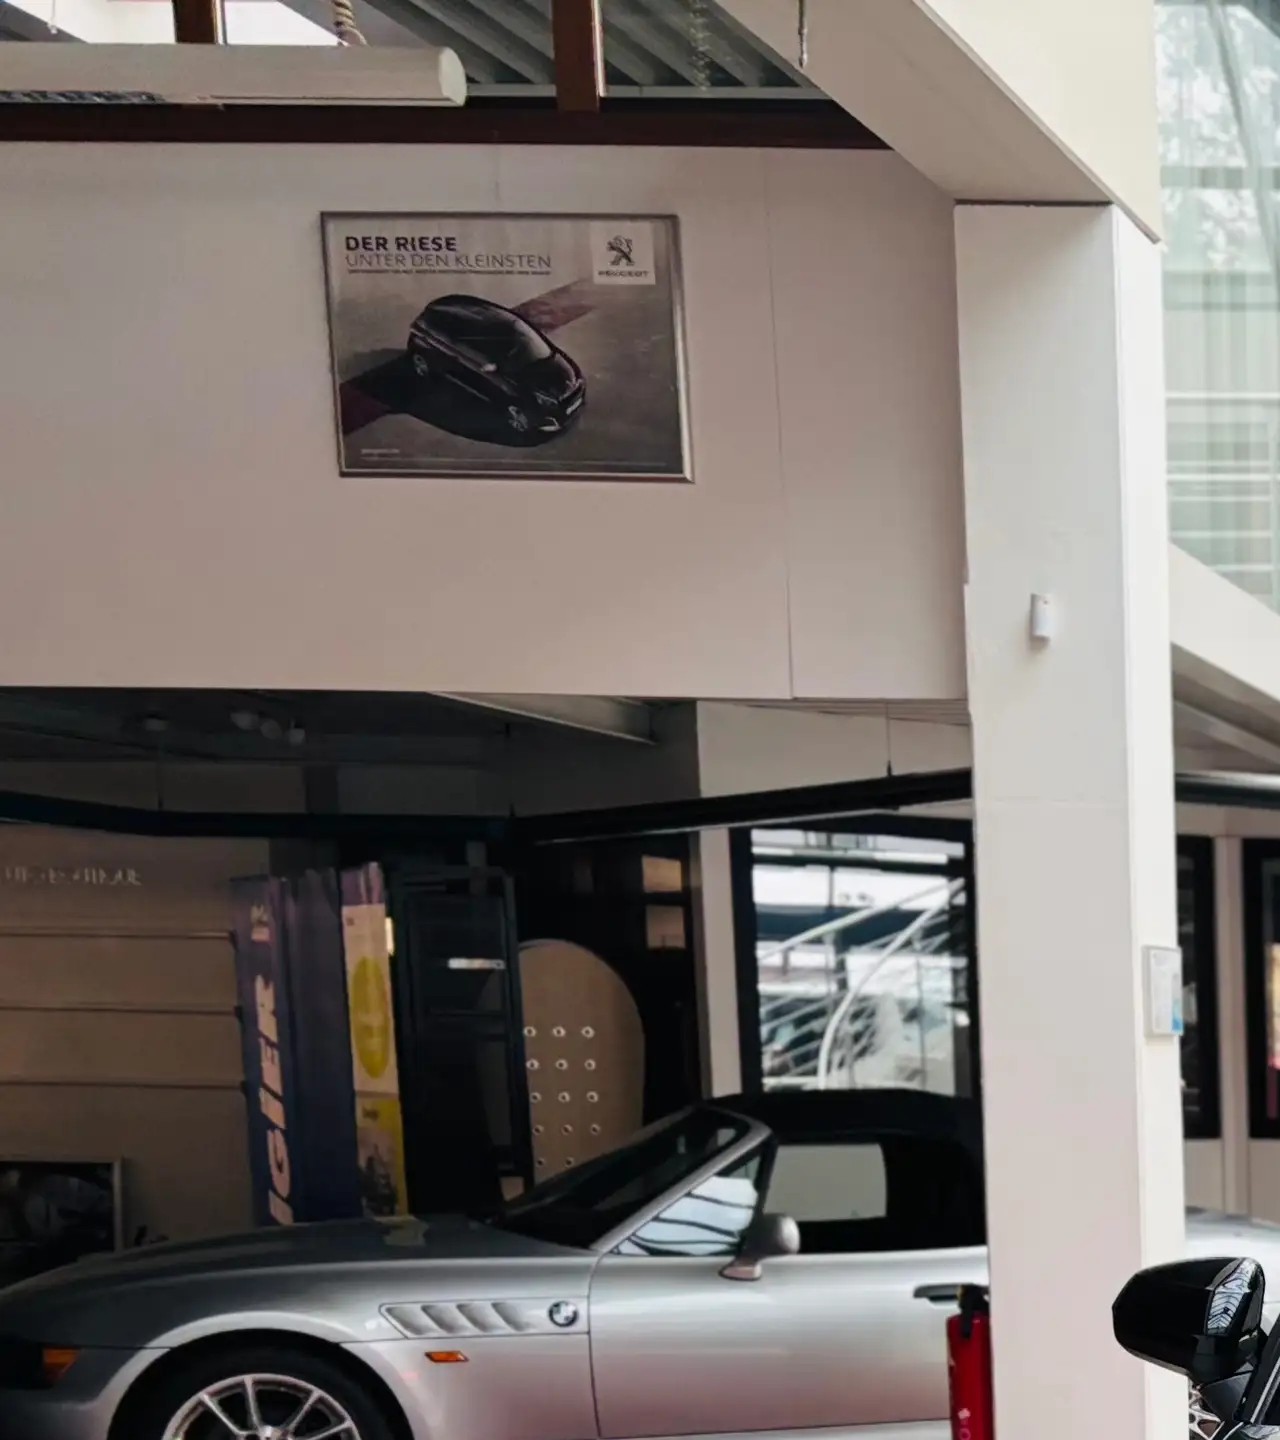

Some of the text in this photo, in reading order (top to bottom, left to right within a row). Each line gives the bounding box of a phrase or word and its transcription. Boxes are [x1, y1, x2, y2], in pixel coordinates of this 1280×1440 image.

[345, 236, 457, 252] DER RIESE
[345, 253, 551, 269] UNTER DEN KLEINSTEN
[254, 974, 294, 1226] IGIER
